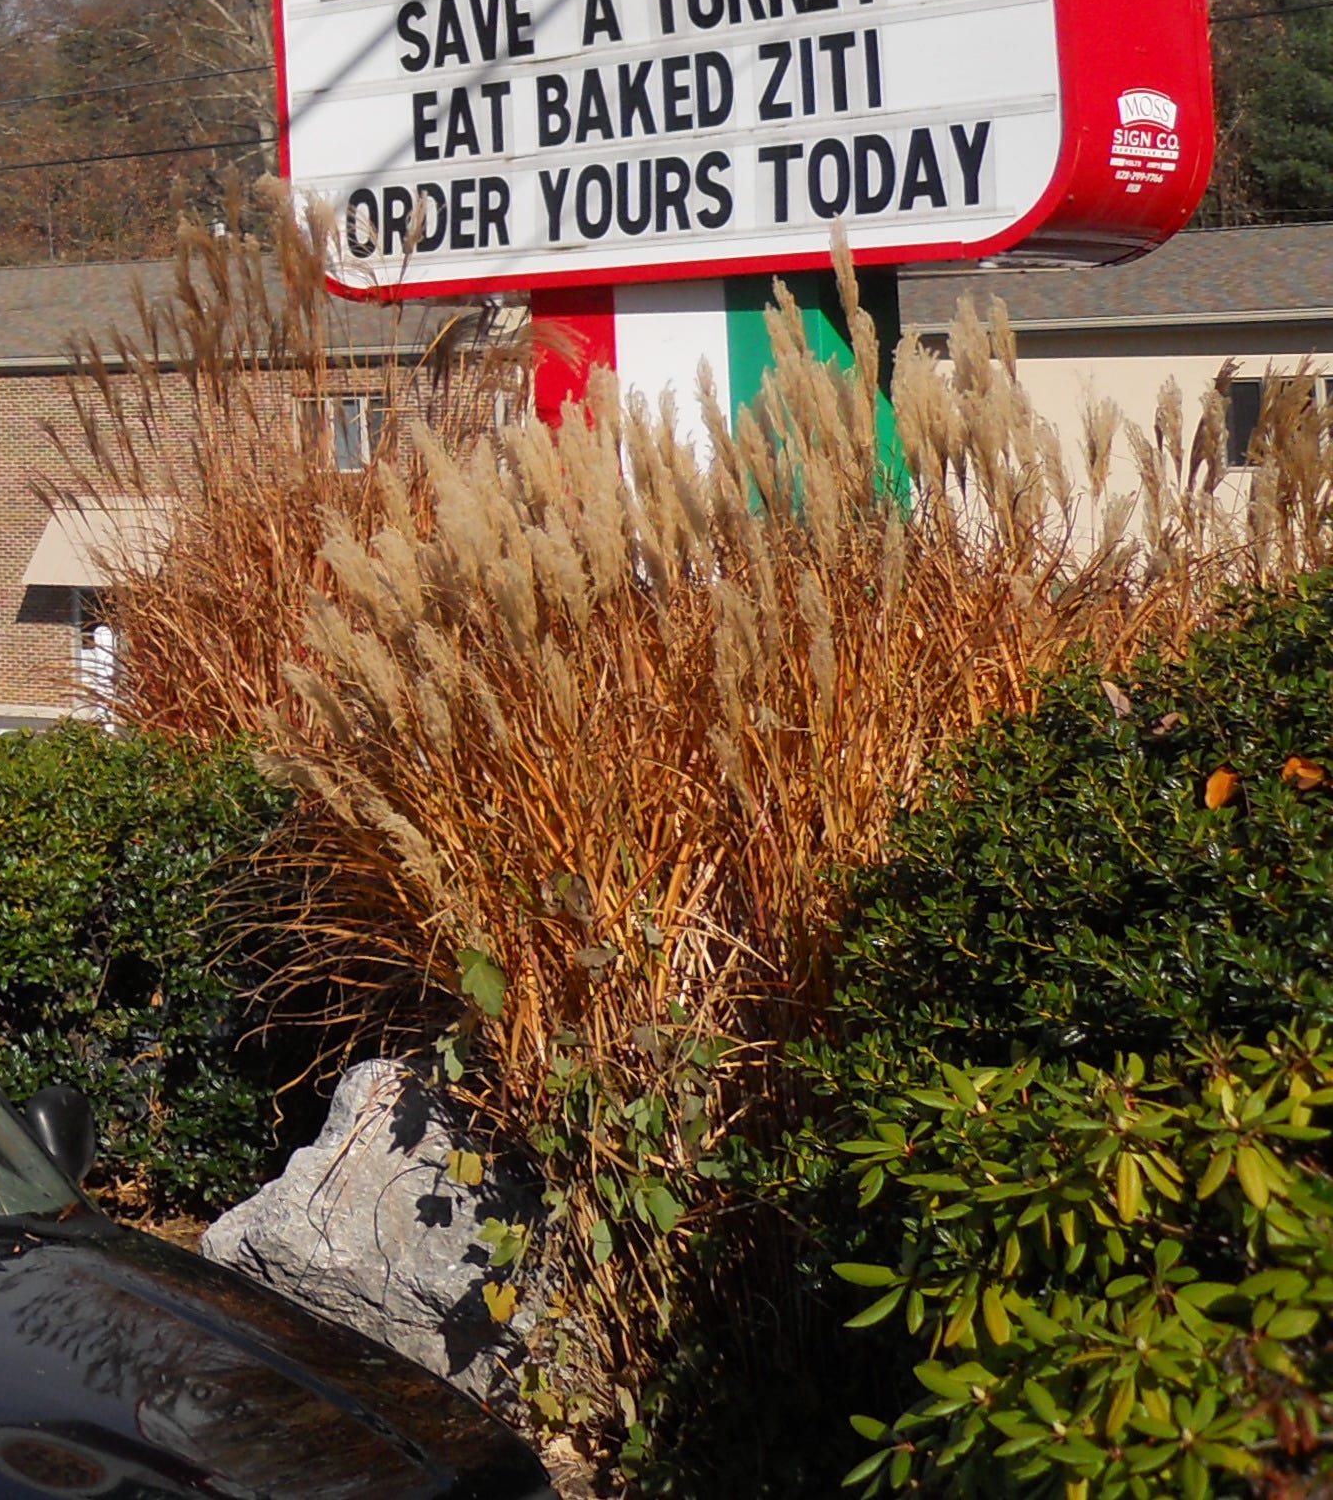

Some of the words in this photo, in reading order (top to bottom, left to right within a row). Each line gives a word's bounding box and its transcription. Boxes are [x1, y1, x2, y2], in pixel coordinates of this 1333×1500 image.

[411, 80, 512, 163] EAT
[535, 50, 735, 148] BAKED
[757, 28, 882, 121] ZITI
[1123, 95, 1171, 123] MOSS
[1113, 128, 1152, 148] SIGN
[346, 175, 512, 258] ORDER
[538, 150, 734, 241] YOURS
[757, 120, 992, 224] TODAY
